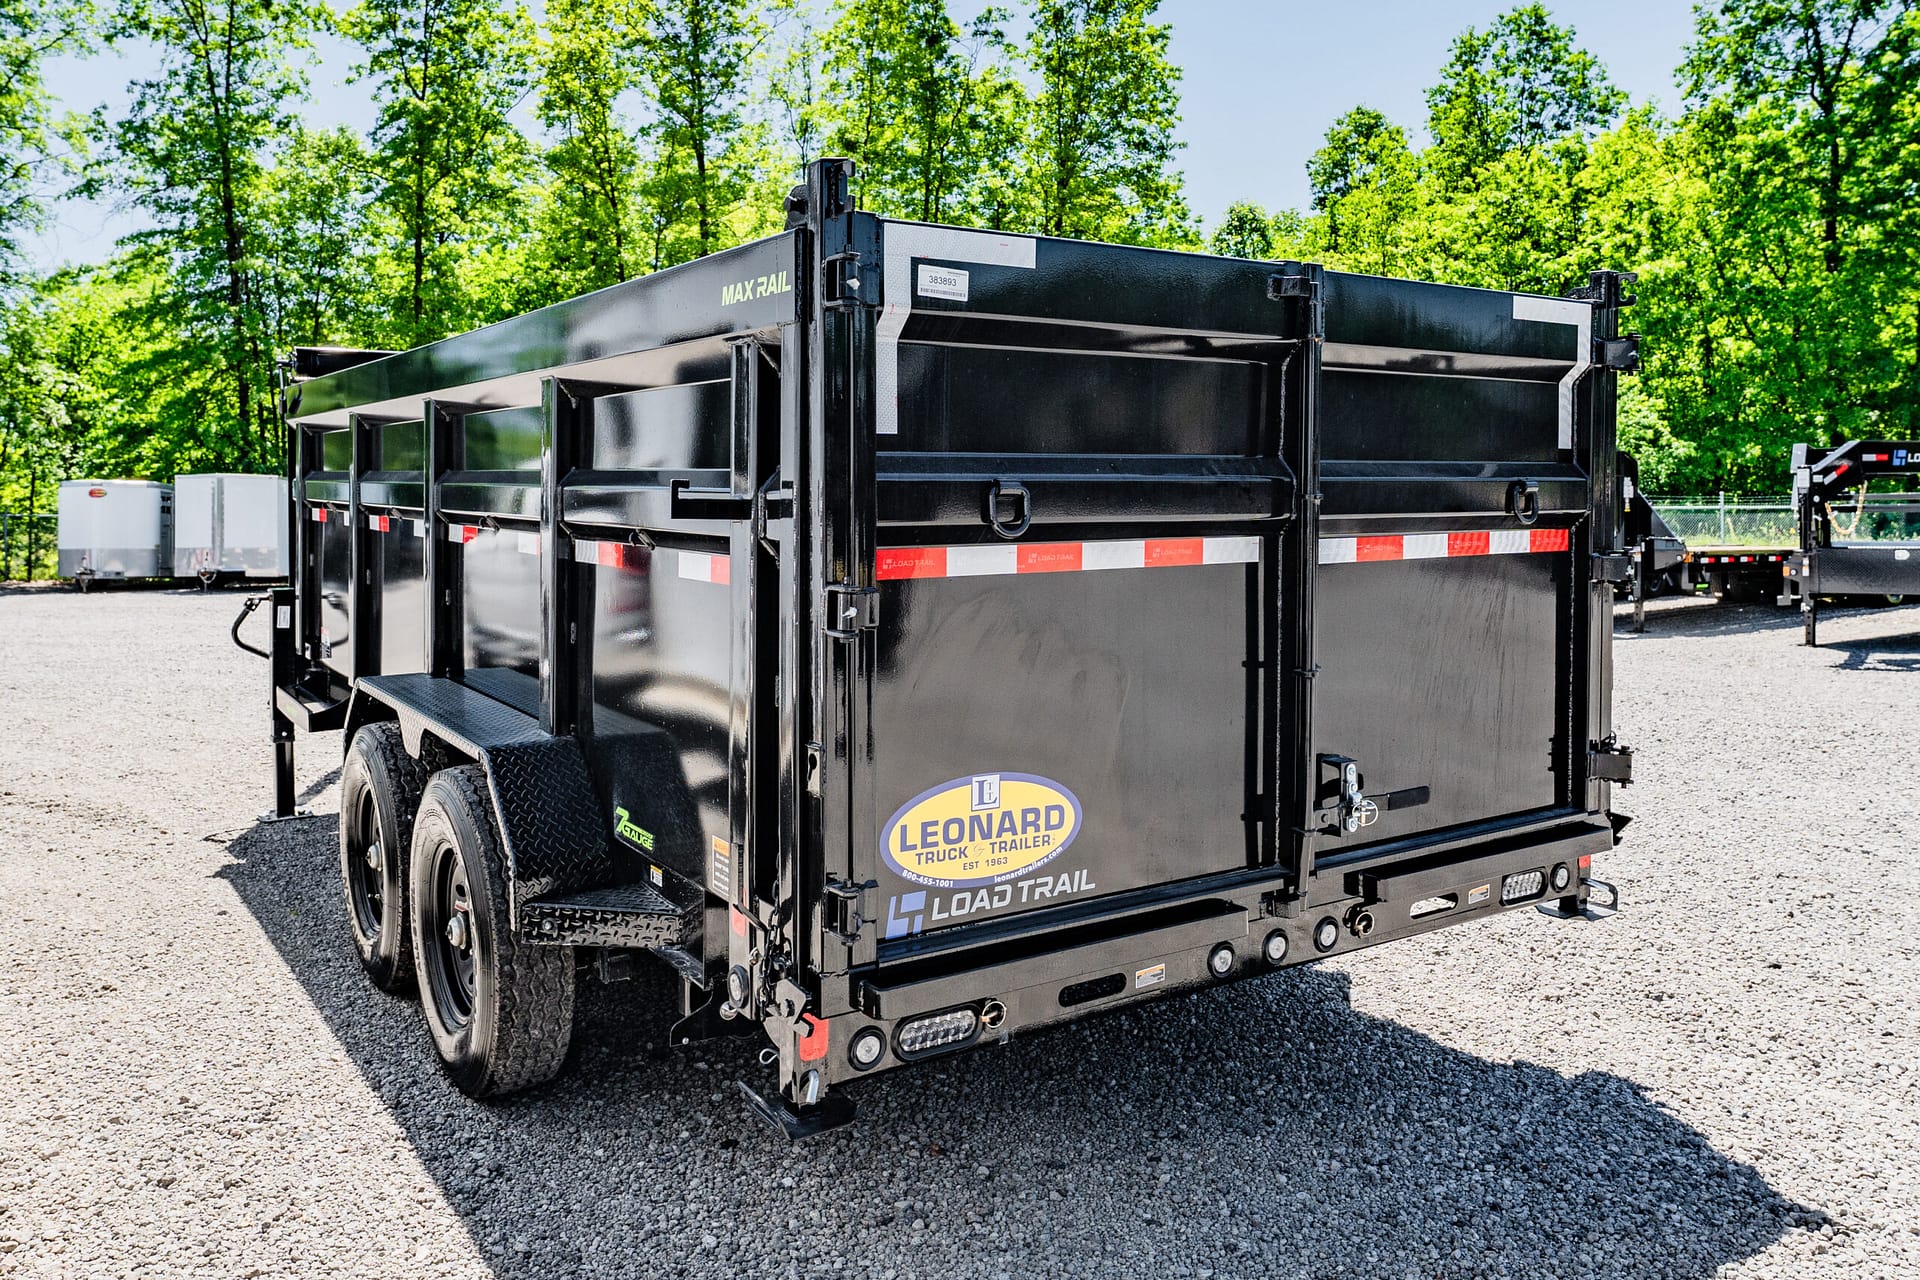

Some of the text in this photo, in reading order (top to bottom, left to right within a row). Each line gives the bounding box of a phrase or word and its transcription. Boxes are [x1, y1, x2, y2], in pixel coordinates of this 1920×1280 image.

[721, 270, 791, 306] MAX RAIL
[928, 275, 957, 287] 383893
[622, 823, 653, 850] GAUGE
[900, 804, 1065, 852] LEONARD
[915, 846, 968, 865] TRUCK
[989, 834, 1051, 854] TRAILER
[963, 857, 1008, 870] EST 1963
[994, 845, 1063, 884] leonardtrailers.com
[902, 869, 954, 888] 800-455-1001
[932, 883, 1012, 921] LOAD
[1018, 869, 1096, 903] TRAIL
